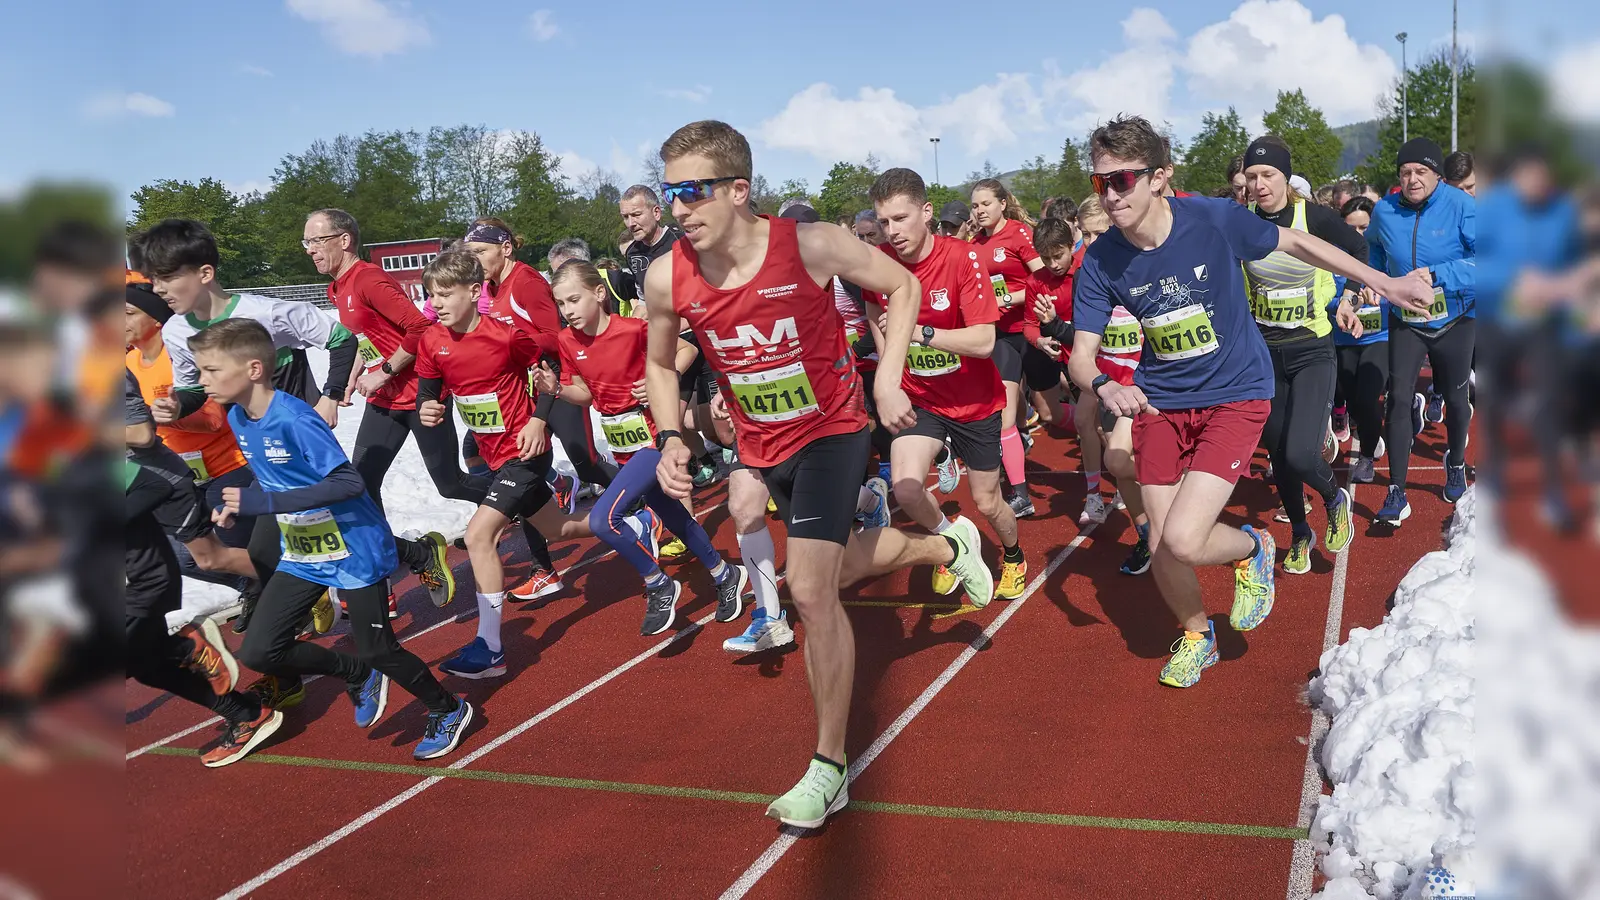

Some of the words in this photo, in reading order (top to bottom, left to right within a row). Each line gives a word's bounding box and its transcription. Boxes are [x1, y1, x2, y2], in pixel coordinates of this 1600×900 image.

[763, 283, 798, 294] INTERSPORT
[764, 290, 793, 299] VOCKEROTH
[1162, 282, 1180, 295] 2023
[1257, 303, 1305, 321] 14779
[704, 316, 800, 357] HM
[1102, 331, 1138, 347] 4718
[1150, 324, 1212, 353] 14716
[761, 347, 803, 363] Melsungen
[907, 352, 958, 369] 14694
[740, 385, 810, 413] 14711
[499, 479, 516, 488] JAKO
[285, 532, 341, 554] 14679
